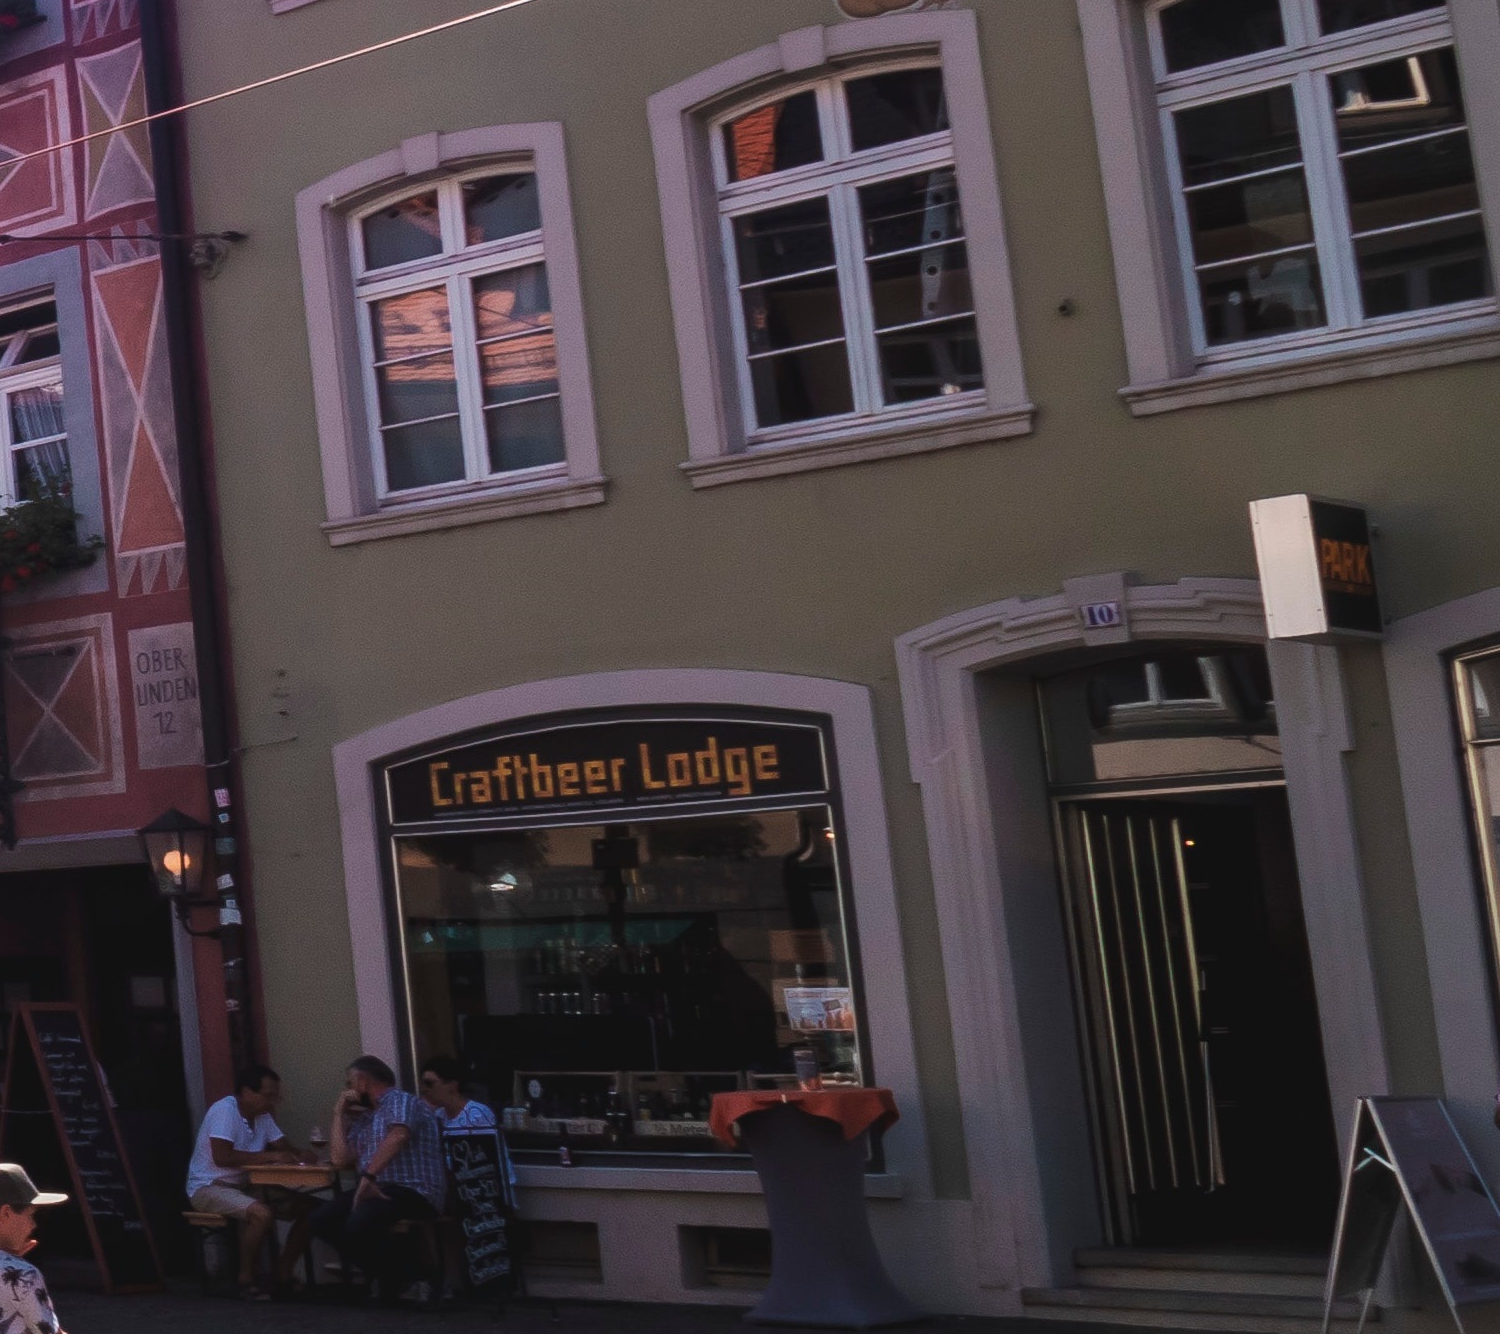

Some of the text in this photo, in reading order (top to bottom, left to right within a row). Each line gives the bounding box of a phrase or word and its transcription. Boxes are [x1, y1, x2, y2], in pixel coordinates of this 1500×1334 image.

[1321, 538, 1372, 585] PARK
[1087, 604, 1114, 625] 10
[153, 711, 177, 734] 12
[428, 753, 627, 807] Craftbeer
[638, 735, 780, 796] Lodge
